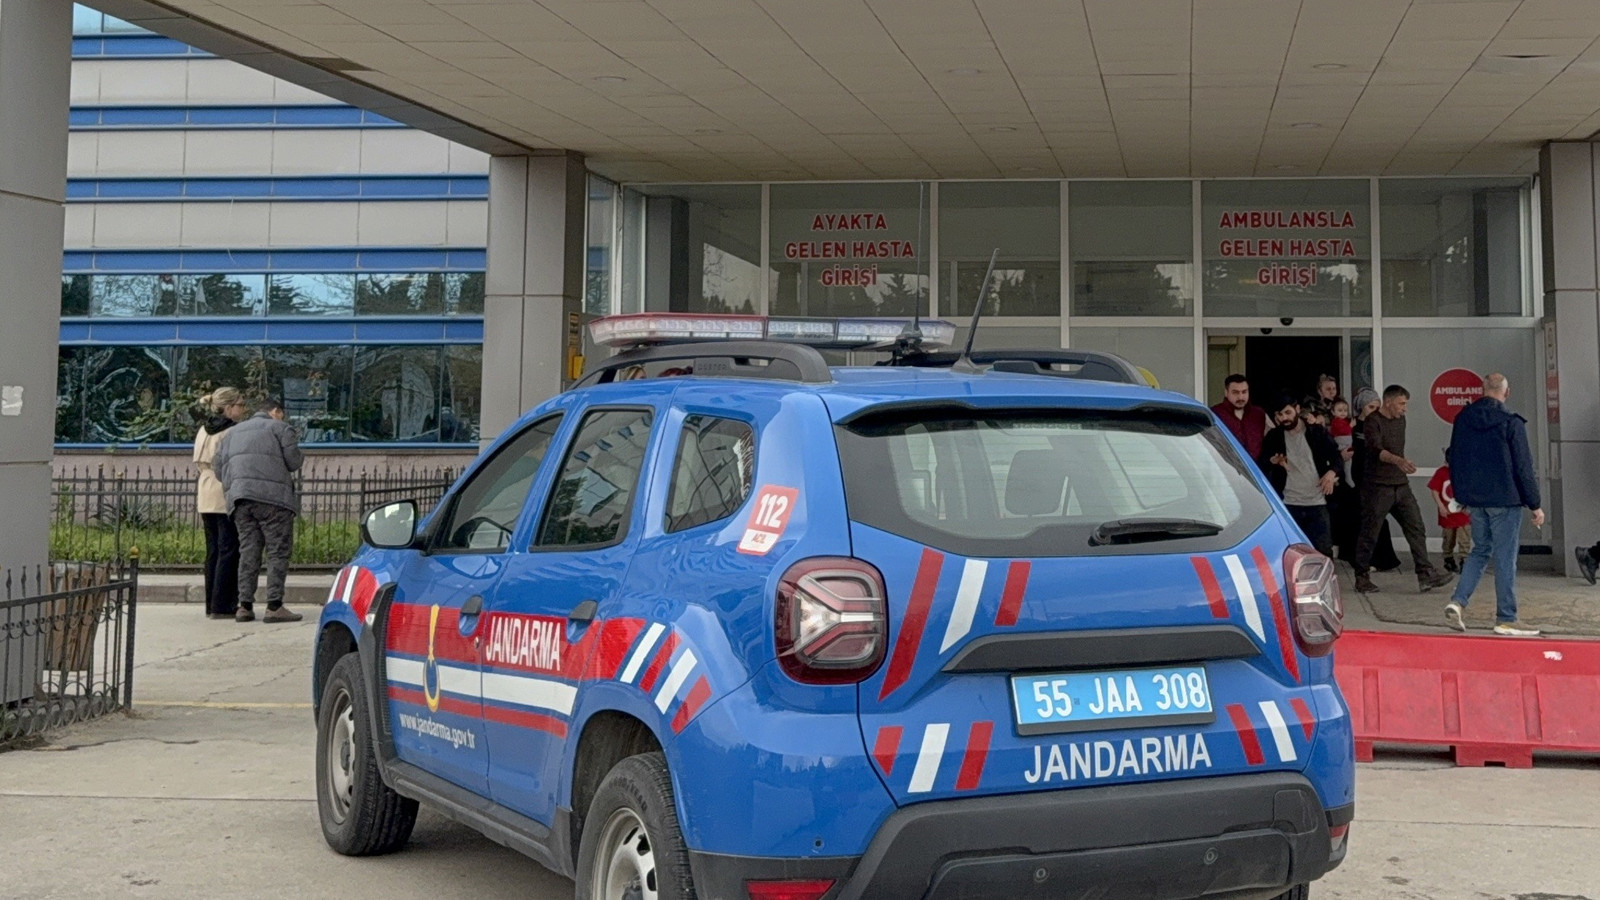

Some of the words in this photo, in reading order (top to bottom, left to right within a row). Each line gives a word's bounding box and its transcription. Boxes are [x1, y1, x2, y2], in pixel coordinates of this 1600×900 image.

[811, 213, 888, 231] AYAKTA
[1219, 210, 1355, 229] AMBULANSLA
[785, 241, 847, 259] GELEN
[852, 240, 915, 259] HASTA
[1219, 239, 1284, 257] GELEN
[1289, 239, 1356, 257] HASTA
[821, 263, 878, 288] GİRİŞİ
[1258, 262, 1317, 287] GİRİŞİ
[1435, 386, 1483, 395] AMBULANS
[755, 493, 789, 529] 112
[486, 615, 561, 672] JANDARMA
[1032, 679, 1073, 718] 55
[1088, 675, 1143, 715] JAA
[1151, 671, 1206, 710] 308
[399, 712, 475, 749] www.jandarma.gov.tr
[1024, 732, 1213, 784] JANDARMA
